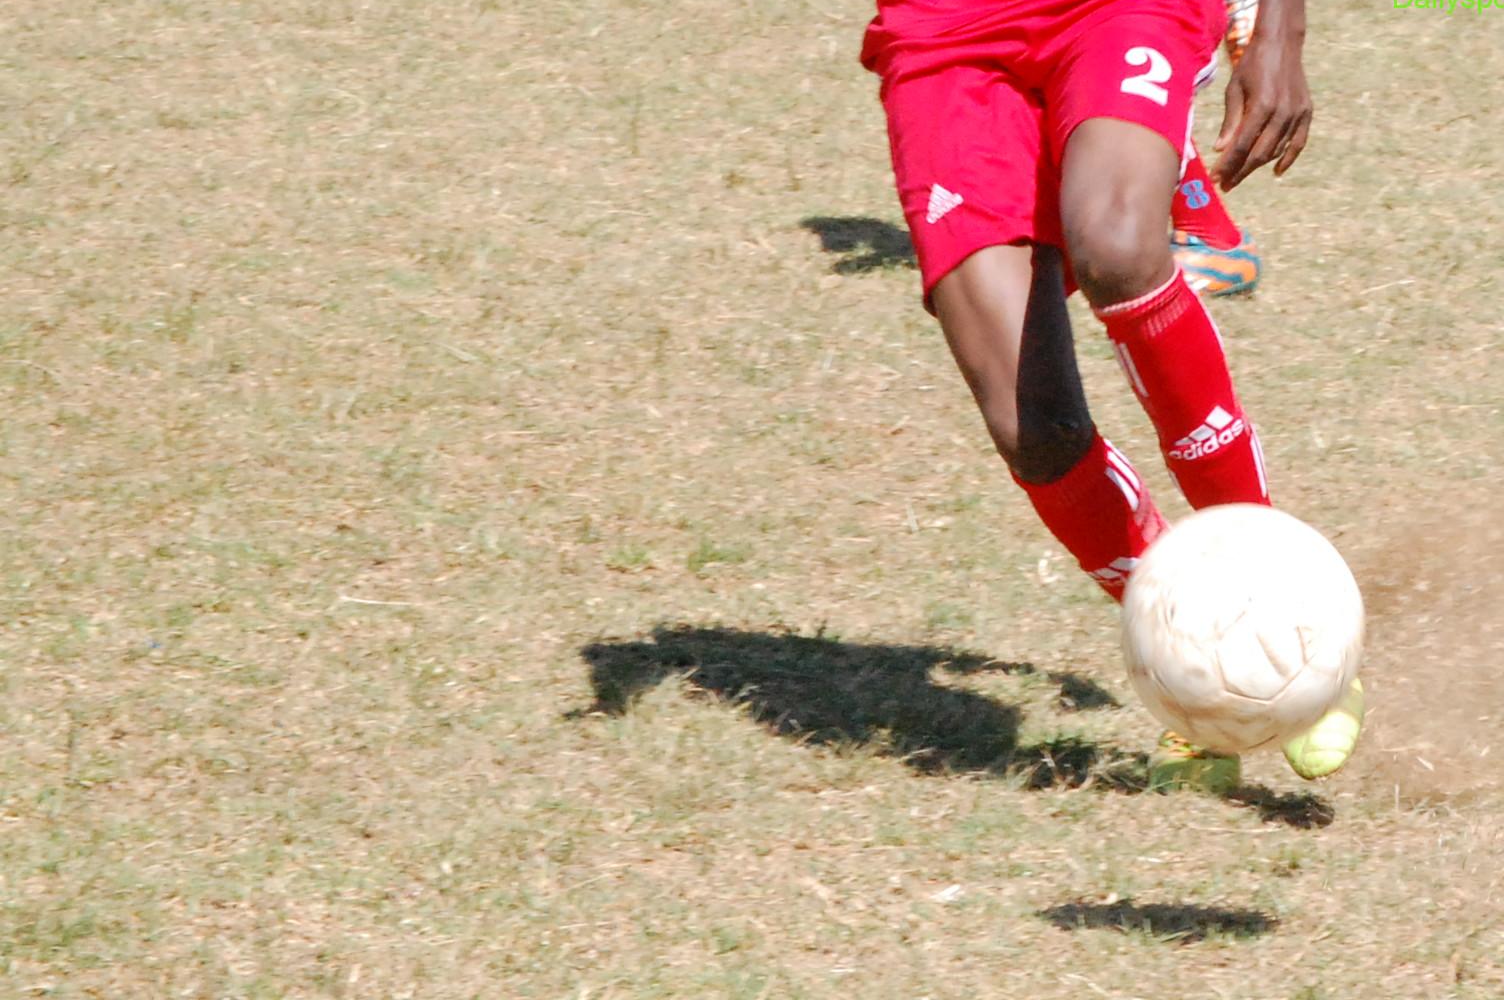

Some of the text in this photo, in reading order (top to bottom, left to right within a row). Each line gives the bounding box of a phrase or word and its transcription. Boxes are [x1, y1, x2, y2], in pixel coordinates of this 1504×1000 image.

[1120, 46, 1173, 106] 2
[1179, 179, 1210, 210] 8
[1168, 417, 1245, 462] adidas
